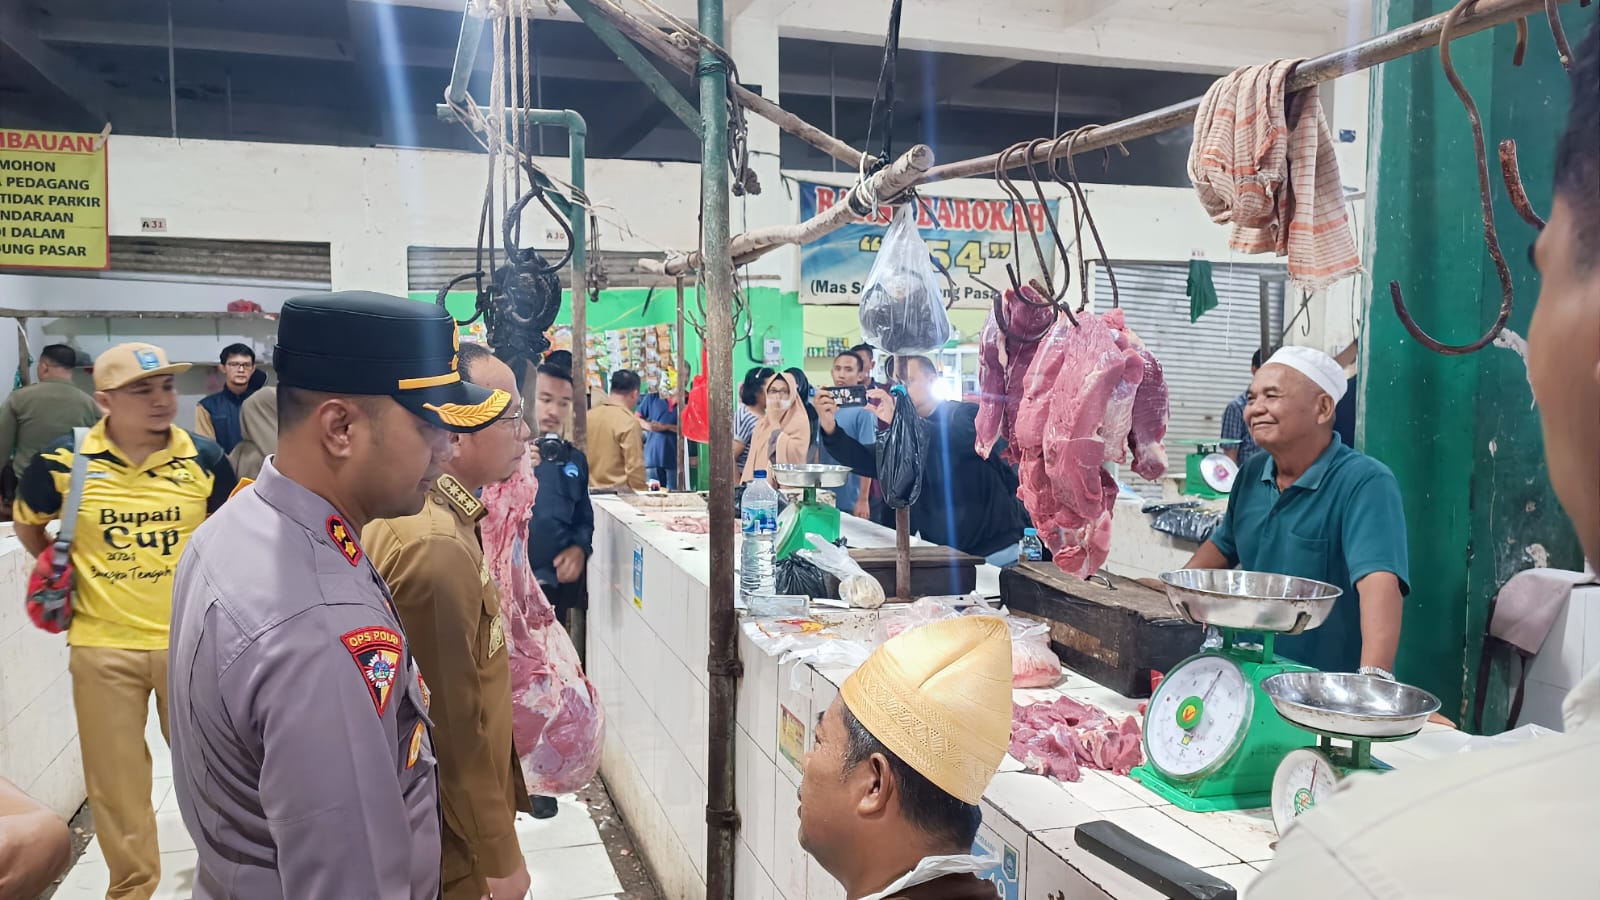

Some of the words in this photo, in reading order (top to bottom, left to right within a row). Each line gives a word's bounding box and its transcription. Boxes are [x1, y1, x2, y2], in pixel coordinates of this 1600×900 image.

[0, 160, 55, 172] MOHON
[7, 177, 89, 190] PEDAGANG
[0, 194, 44, 205] TIDAK
[48, 195, 100, 207] PARKIR
[917, 196, 1044, 232] BAROKAH
[11, 227, 65, 239] DALAM
[0, 244, 34, 255] UNG
[39, 245, 86, 256] PASAR
[810, 279, 847, 297] (Mas
[98, 506, 181, 527] Bupati
[103, 525, 179, 556] Cup
[349, 632, 371, 647] OPS
